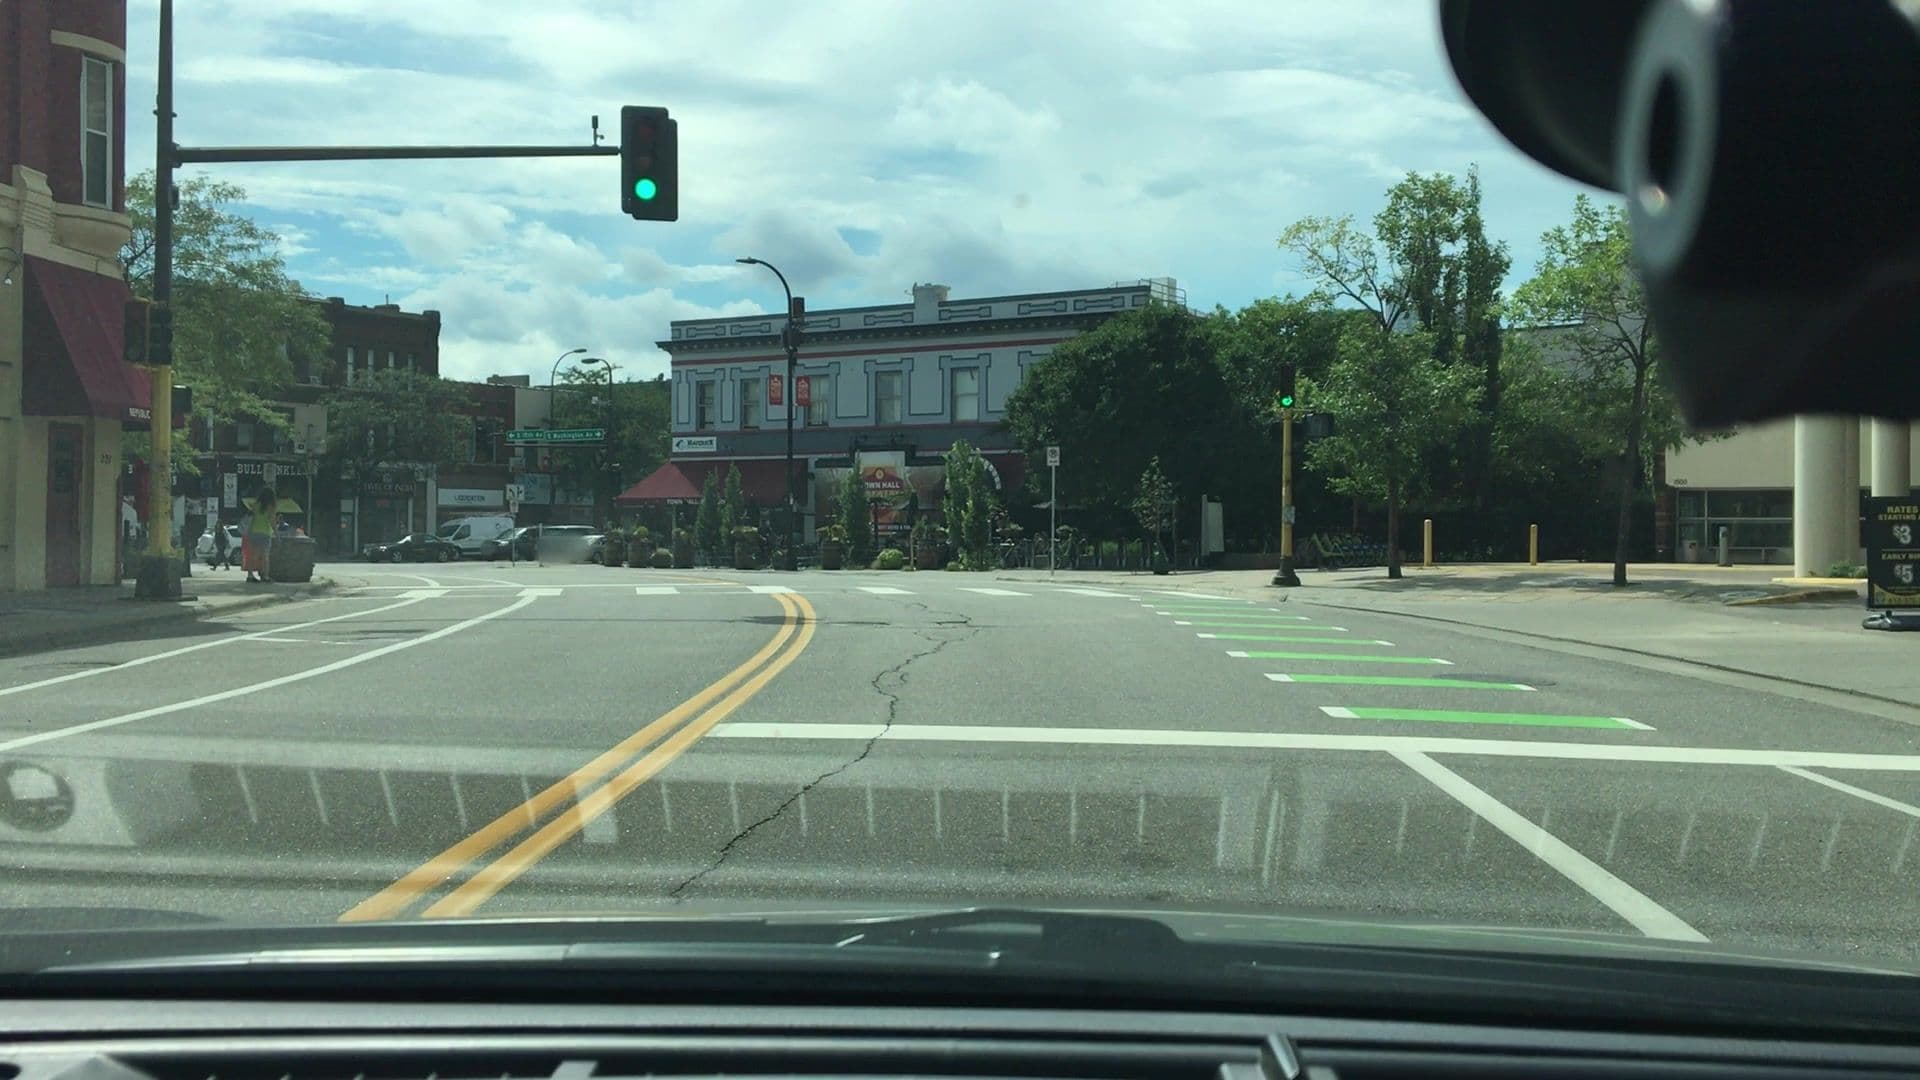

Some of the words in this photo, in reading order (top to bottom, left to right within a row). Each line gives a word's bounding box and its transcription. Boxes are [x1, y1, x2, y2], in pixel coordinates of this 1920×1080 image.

[1887, 505, 1918, 514] RATES
[1878, 513, 1916, 521] STARTING
[1892, 525, 1912, 545] $3
[1893, 564, 1914, 583] $5
